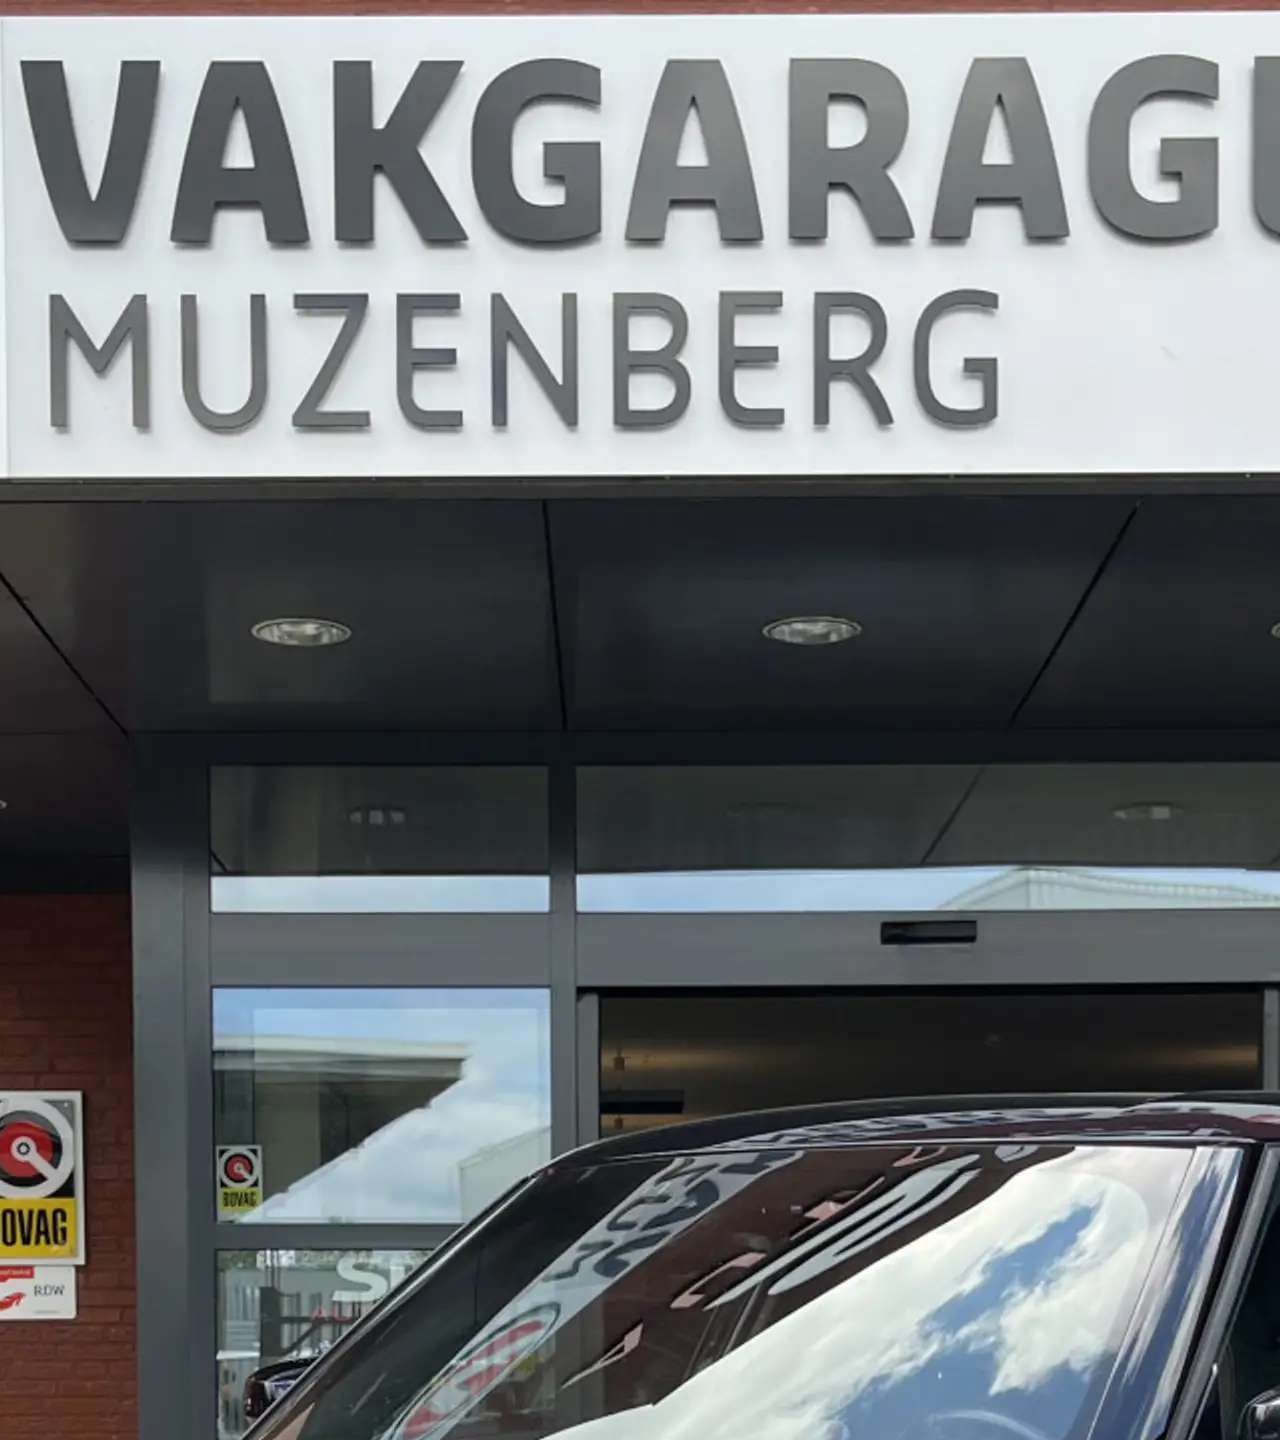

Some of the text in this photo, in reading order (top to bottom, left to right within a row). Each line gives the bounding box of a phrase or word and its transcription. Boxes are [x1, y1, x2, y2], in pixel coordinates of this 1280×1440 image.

[49, 289, 1000, 431] MUZENBERG
[223, 1191, 256, 1207] BOVAG
[33, 1285, 65, 1297] RDW
